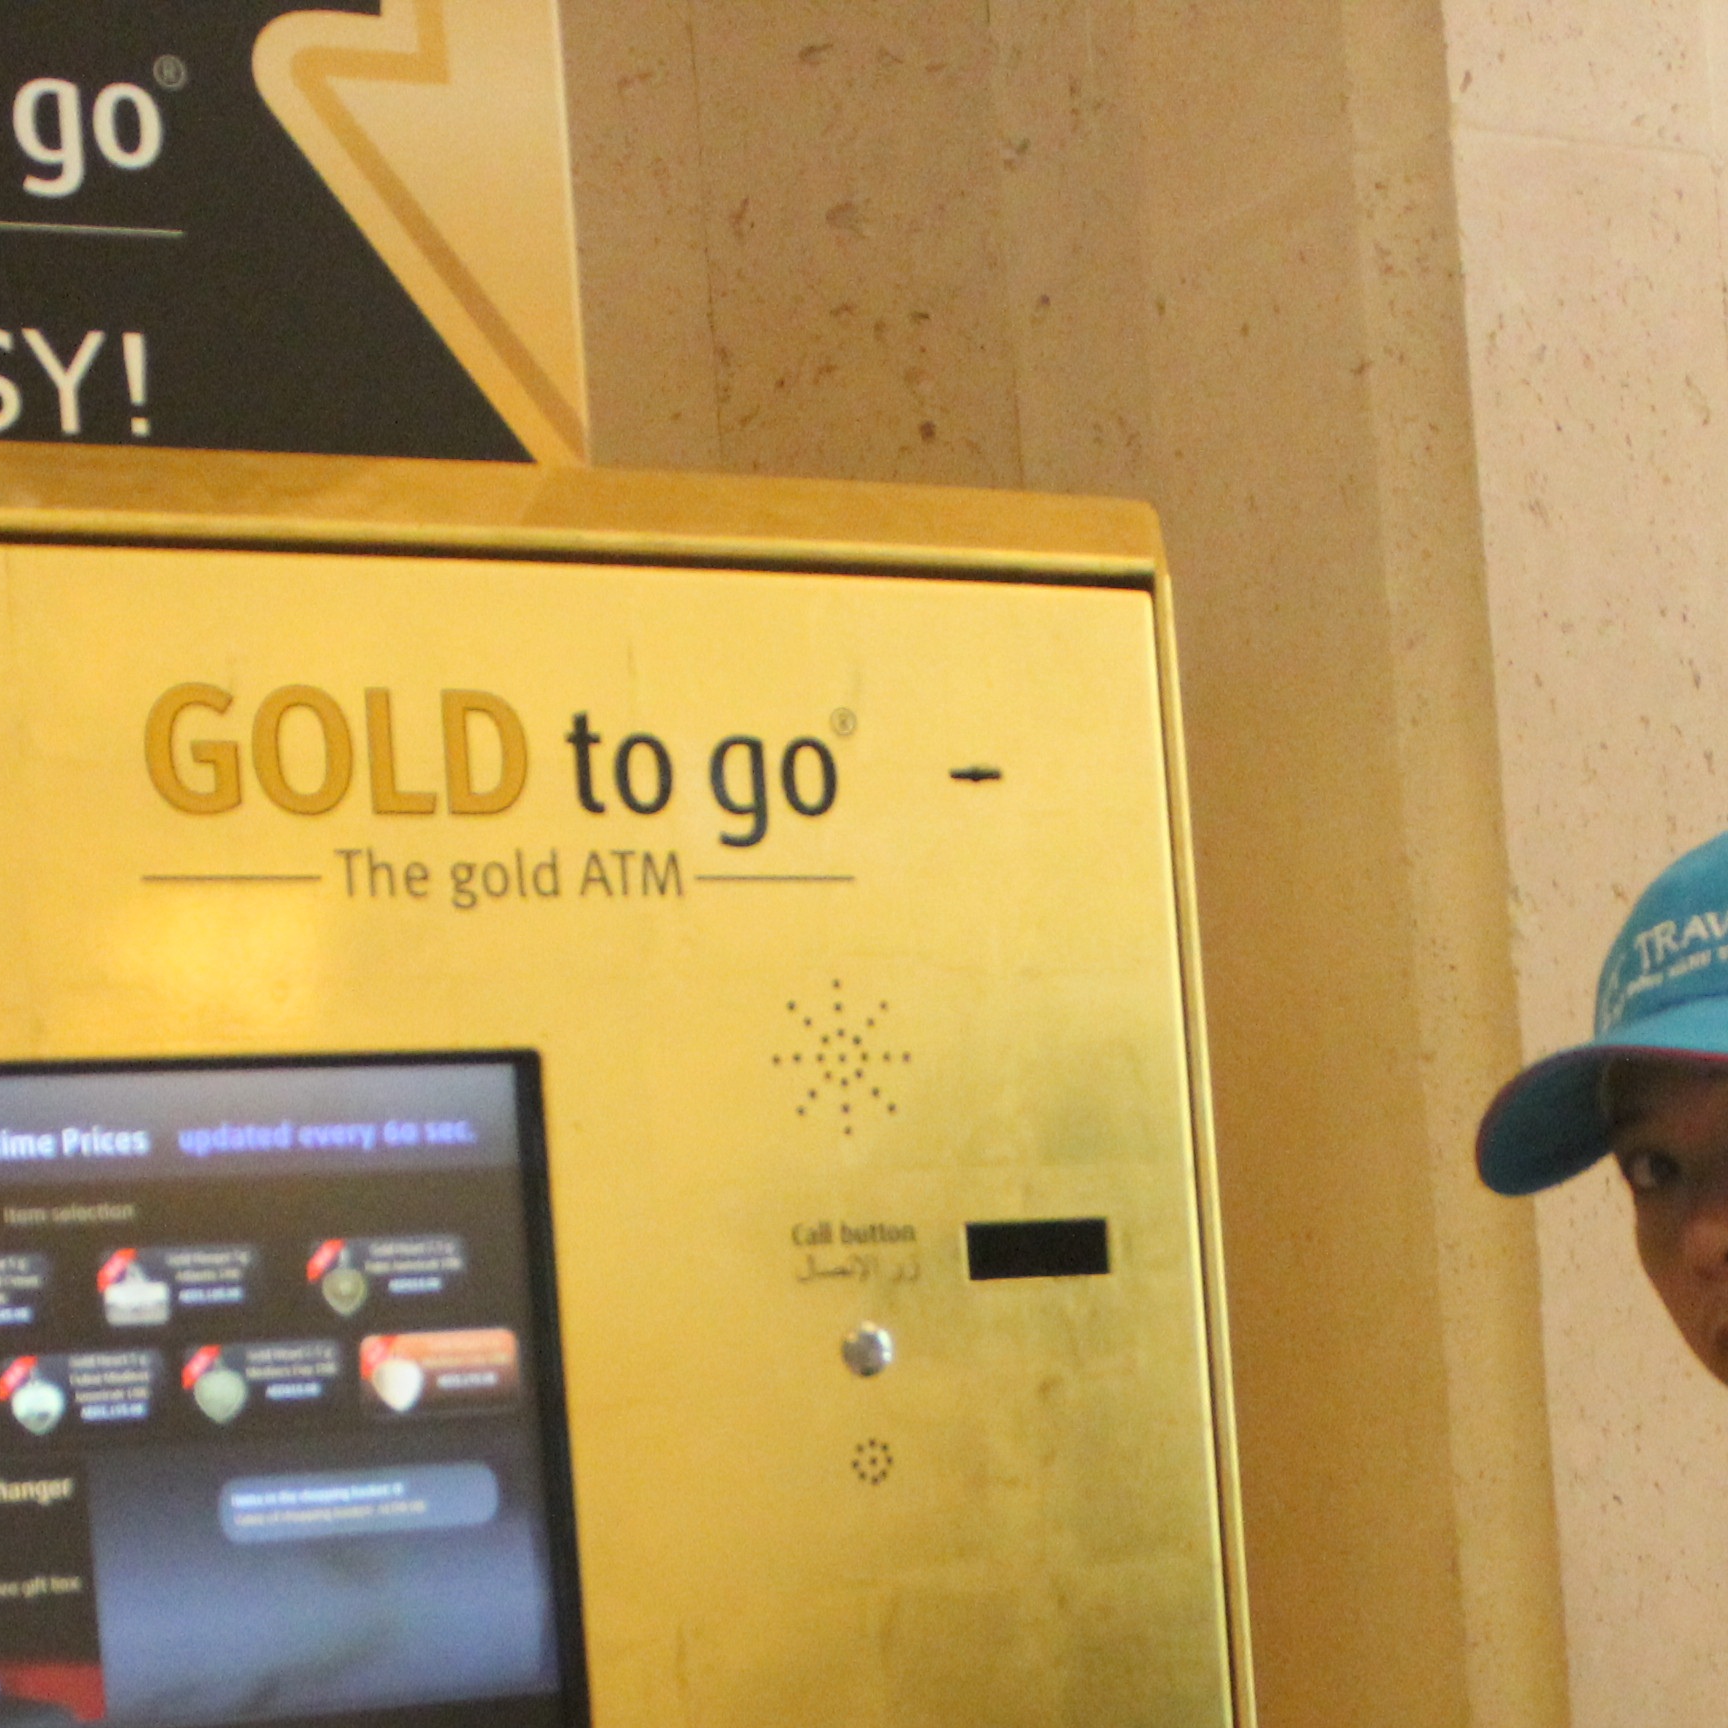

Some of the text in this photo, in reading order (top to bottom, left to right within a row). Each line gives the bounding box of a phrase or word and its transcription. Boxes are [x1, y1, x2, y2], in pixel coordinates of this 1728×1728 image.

[143, 681, 528, 818] GOLD
[565, 711, 674, 816] to
[334, 848, 685, 909] The gold ATM
[62, 1126, 151, 1157] Prices
[177, 1122, 293, 1157] updated
[298, 1123, 376, 1151] every
[791, 1219, 917, 1247] Call button
